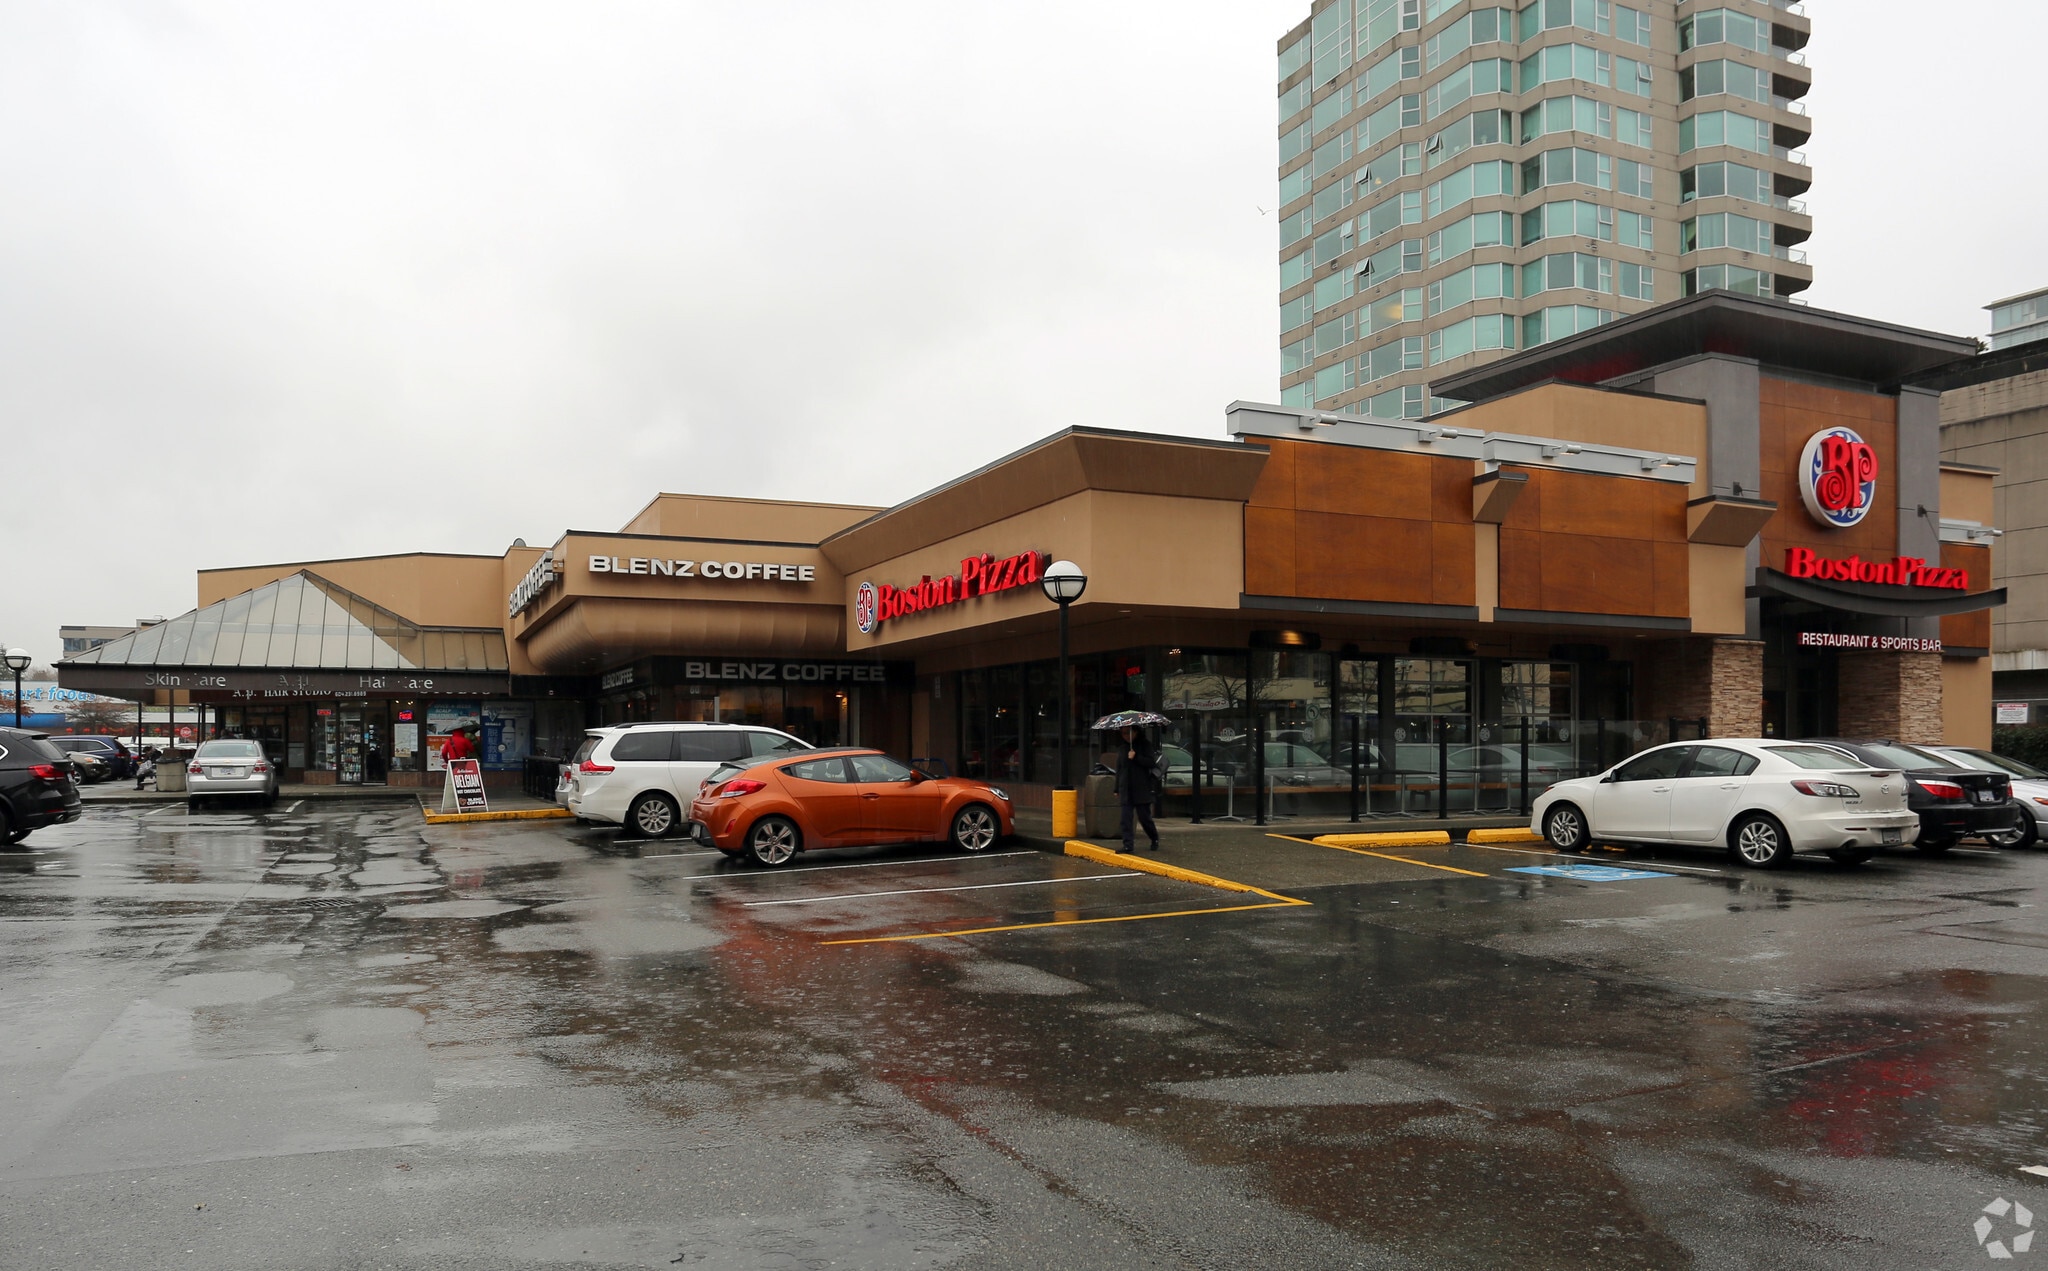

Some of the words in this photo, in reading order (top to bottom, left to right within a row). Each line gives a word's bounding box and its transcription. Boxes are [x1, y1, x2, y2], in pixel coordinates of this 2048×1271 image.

[589, 555, 695, 578] BLENZ
[701, 561, 815, 582] COFFEE
[1785, 547, 1893, 585] Boston
[1892, 556, 1969, 590] Pizza
[877, 575, 957, 622] Boston
[960, 550, 1043, 600] Pizza
[1802, 632, 1869, 648] RESTAURANT
[1871, 636, 1879, 648] &
[1881, 636, 1919, 650] SPORTS
[1921, 639, 1942, 651] BAR
[145, 672, 181, 686] Skin
[192, 673, 226, 687] are
[685, 661, 777, 680] BLENZ
[782, 664, 886, 682] COFFEE
[359, 676, 388, 689] Hai
[48, 685, 97, 702] foods
[454, 774, 481, 788] BELGIAN
